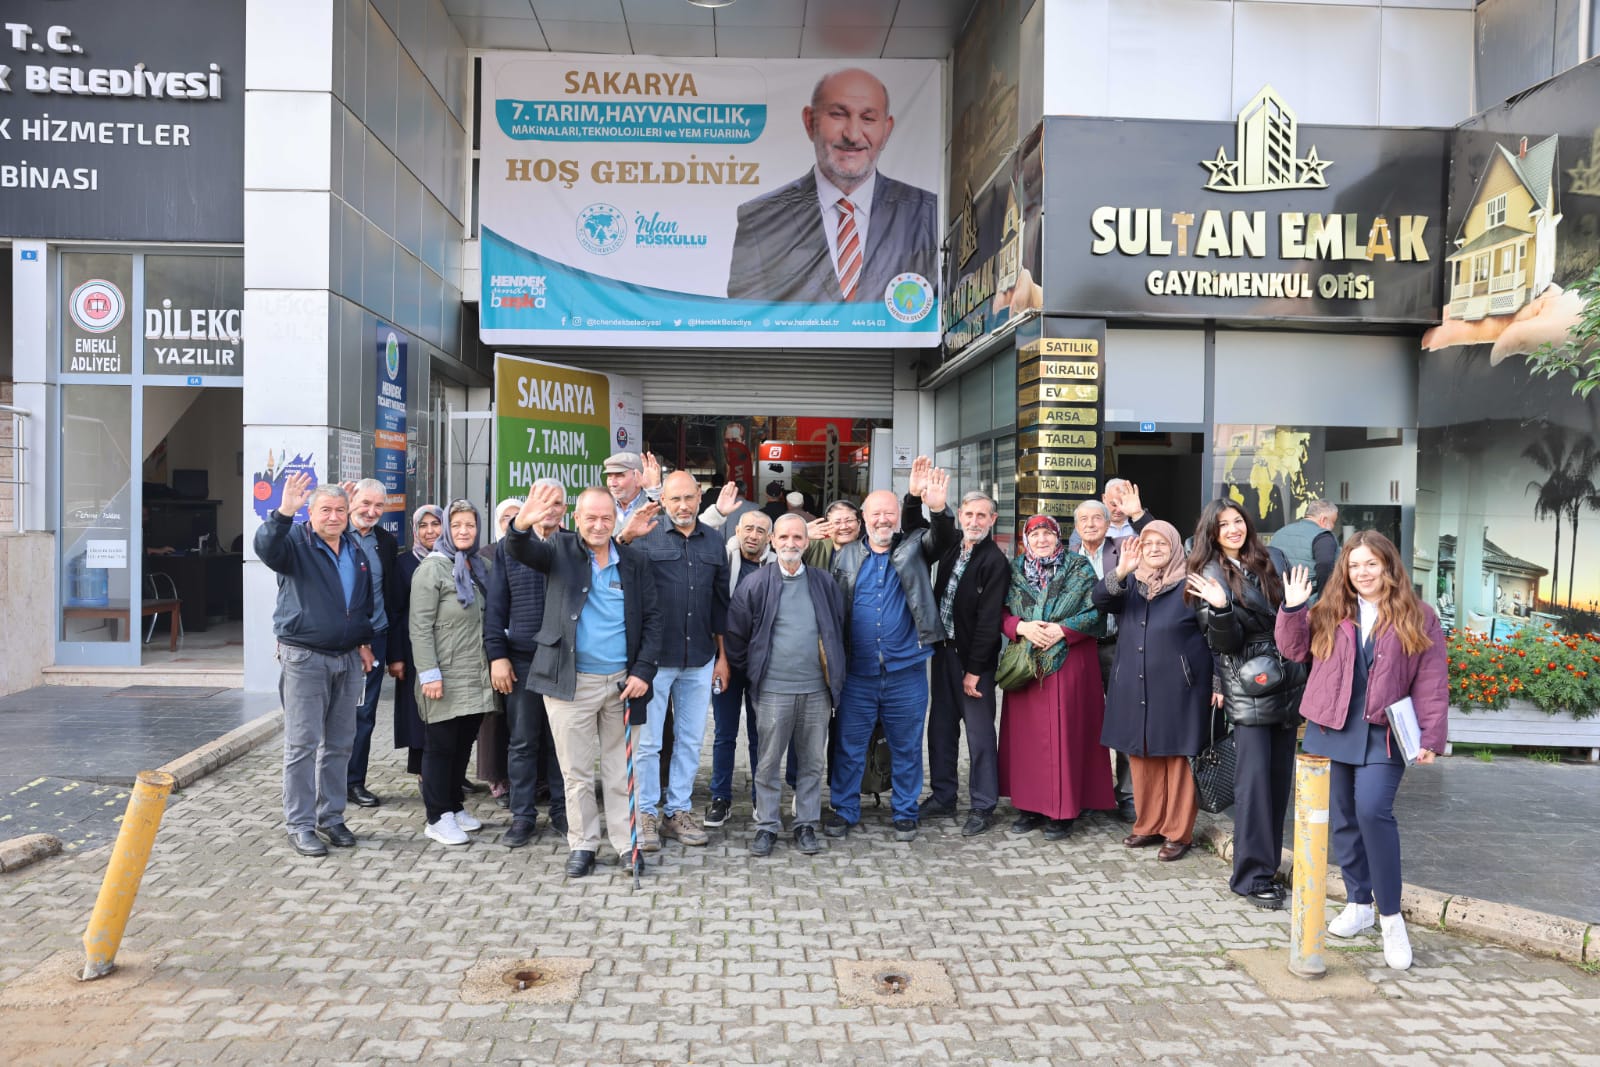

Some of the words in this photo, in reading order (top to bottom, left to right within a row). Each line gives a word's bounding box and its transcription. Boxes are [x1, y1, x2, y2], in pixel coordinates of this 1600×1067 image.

[25, 62, 222, 99] BELEDİYESİ
[564, 70, 698, 97] SAKARYA
[511, 103, 530, 121] 7.
[534, 104, 751, 128] TARIM,HAYVANCILIK,
[22, 113, 191, 146] HİZMETLER
[664, 128, 677, 138] ve
[679, 128, 701, 138] YEM
[703, 129, 751, 139] FUARINA
[1, 160, 98, 190] BİNASI
[505, 158, 580, 189] HOŞ
[590, 154, 760, 185] GELDİNİZ
[634, 210, 679, 236] İrfan
[1091, 205, 1266, 258] SULTAN
[1281, 211, 1430, 262] EMLAK
[491, 275, 546, 287] HENDEK
[1147, 268, 1313, 299] GAYRİMENKUL
[1317, 271, 1375, 300] OFİSİ
[145, 299, 244, 345] DİLEKÇ
[75, 336, 117, 354] EMEKLİ
[154, 347, 235, 366] YAZILIR
[1046, 341, 1093, 354] SATILIK
[70, 354, 121, 372] ADLİYECİ
[1045, 363, 1096, 376] KİRALIK
[517, 376, 596, 416] SAKARYA
[1046, 387, 1062, 398] EV
[1046, 411, 1081, 422] ARSA
[526, 427, 541, 454] 7.
[542, 429, 589, 460] TARIM,
[1046, 434, 1086, 445] TARLA
[1044, 457, 1092, 468] FABRİKA
